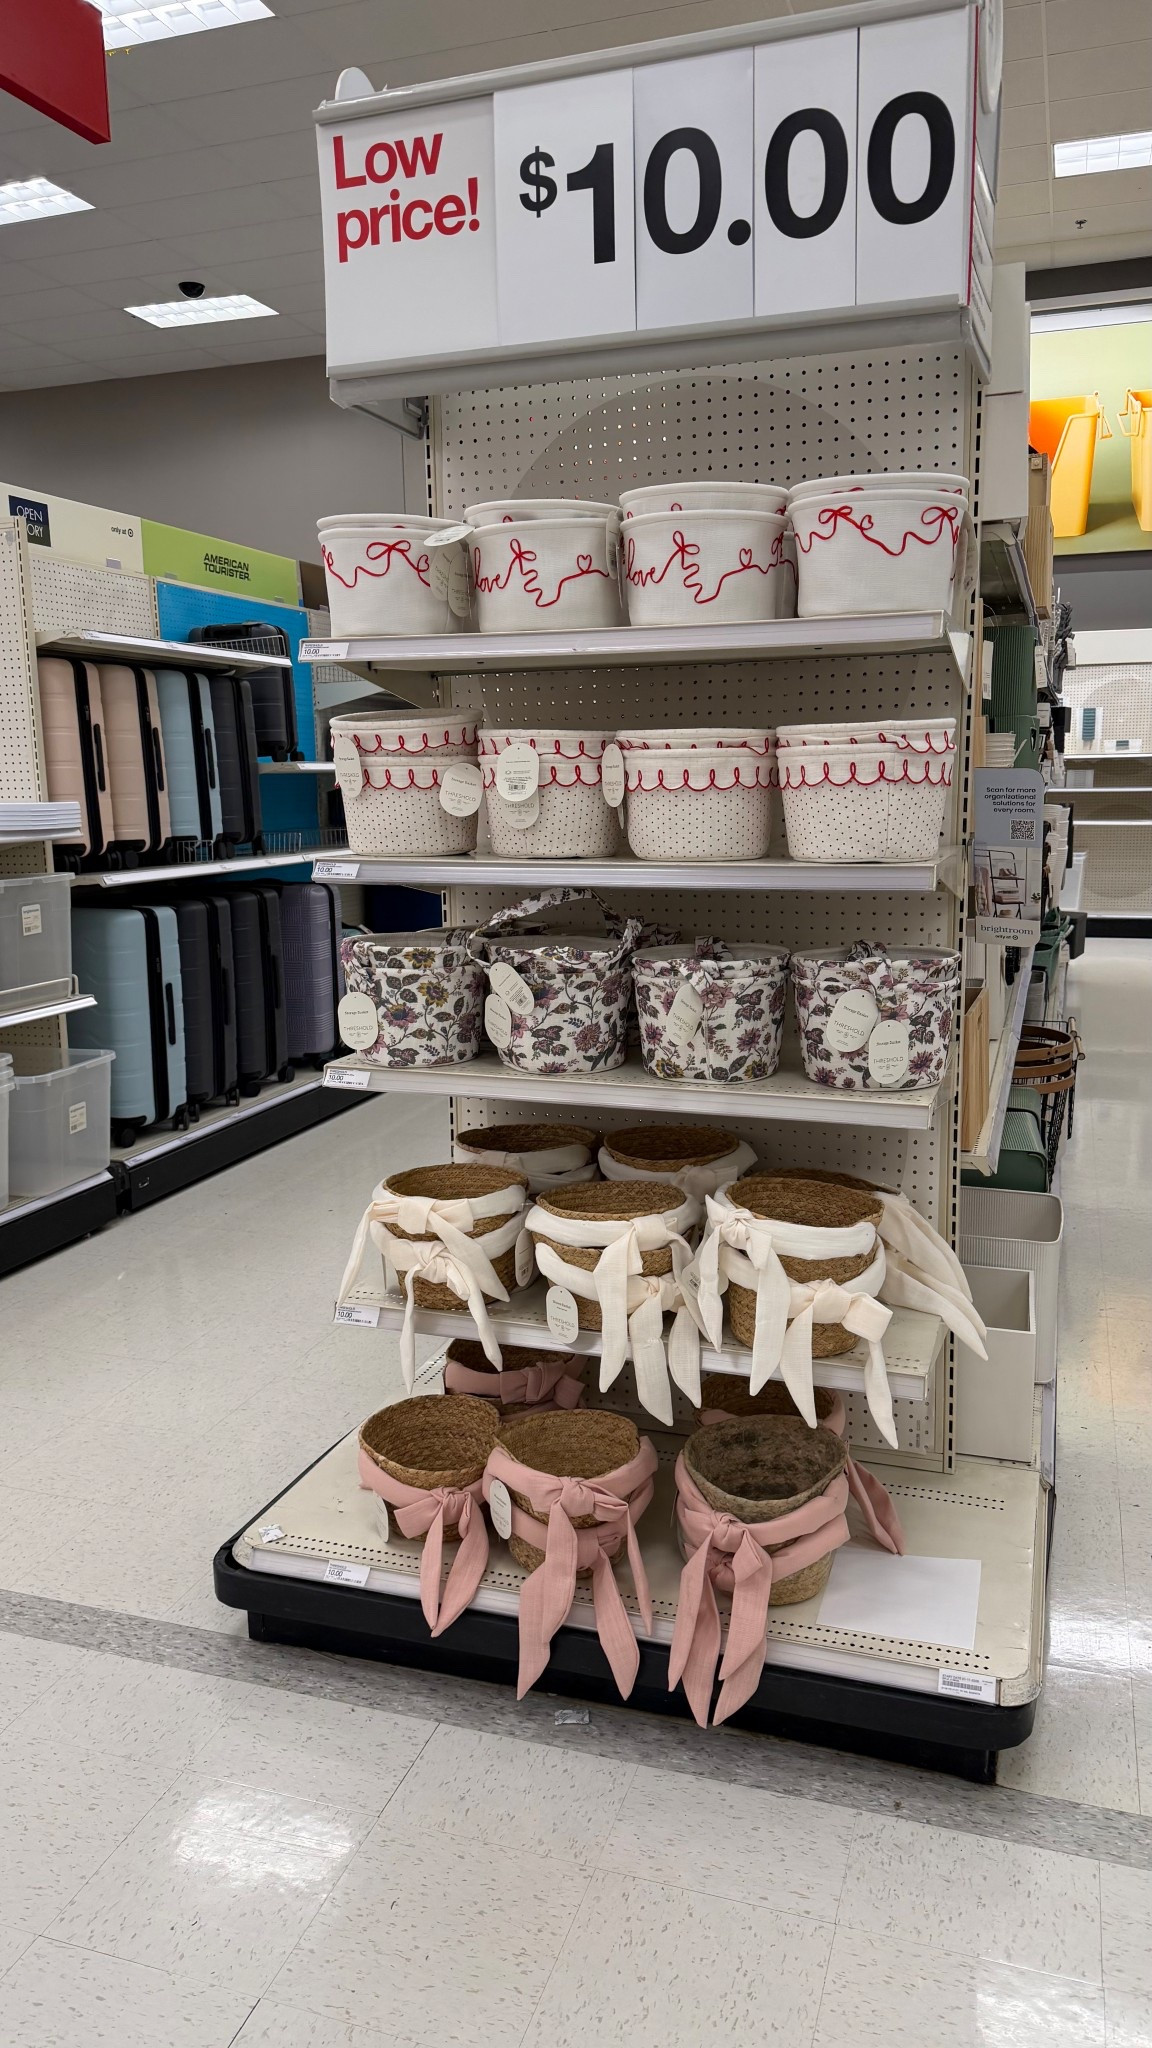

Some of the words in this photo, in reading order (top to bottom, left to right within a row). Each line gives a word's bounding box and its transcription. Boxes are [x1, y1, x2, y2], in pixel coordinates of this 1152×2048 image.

[333, 133, 443, 189] Low
[518, 90, 956, 264] $10.00
[337, 177, 480, 263] price!
[16, 505, 43, 522] OPEN
[203, 552, 249, 571] AMERICAN
[474, 547, 503, 592] love
[626, 538, 659, 587] love
[445, 790, 477, 802] THRESHOLD
[980, 924, 1034, 935] brightroom
[834, 1020, 865, 1037] THRESHOLD
[873, 1056, 904, 1064] THRESHOLD
[328, 1569, 343, 1577] 10.00
